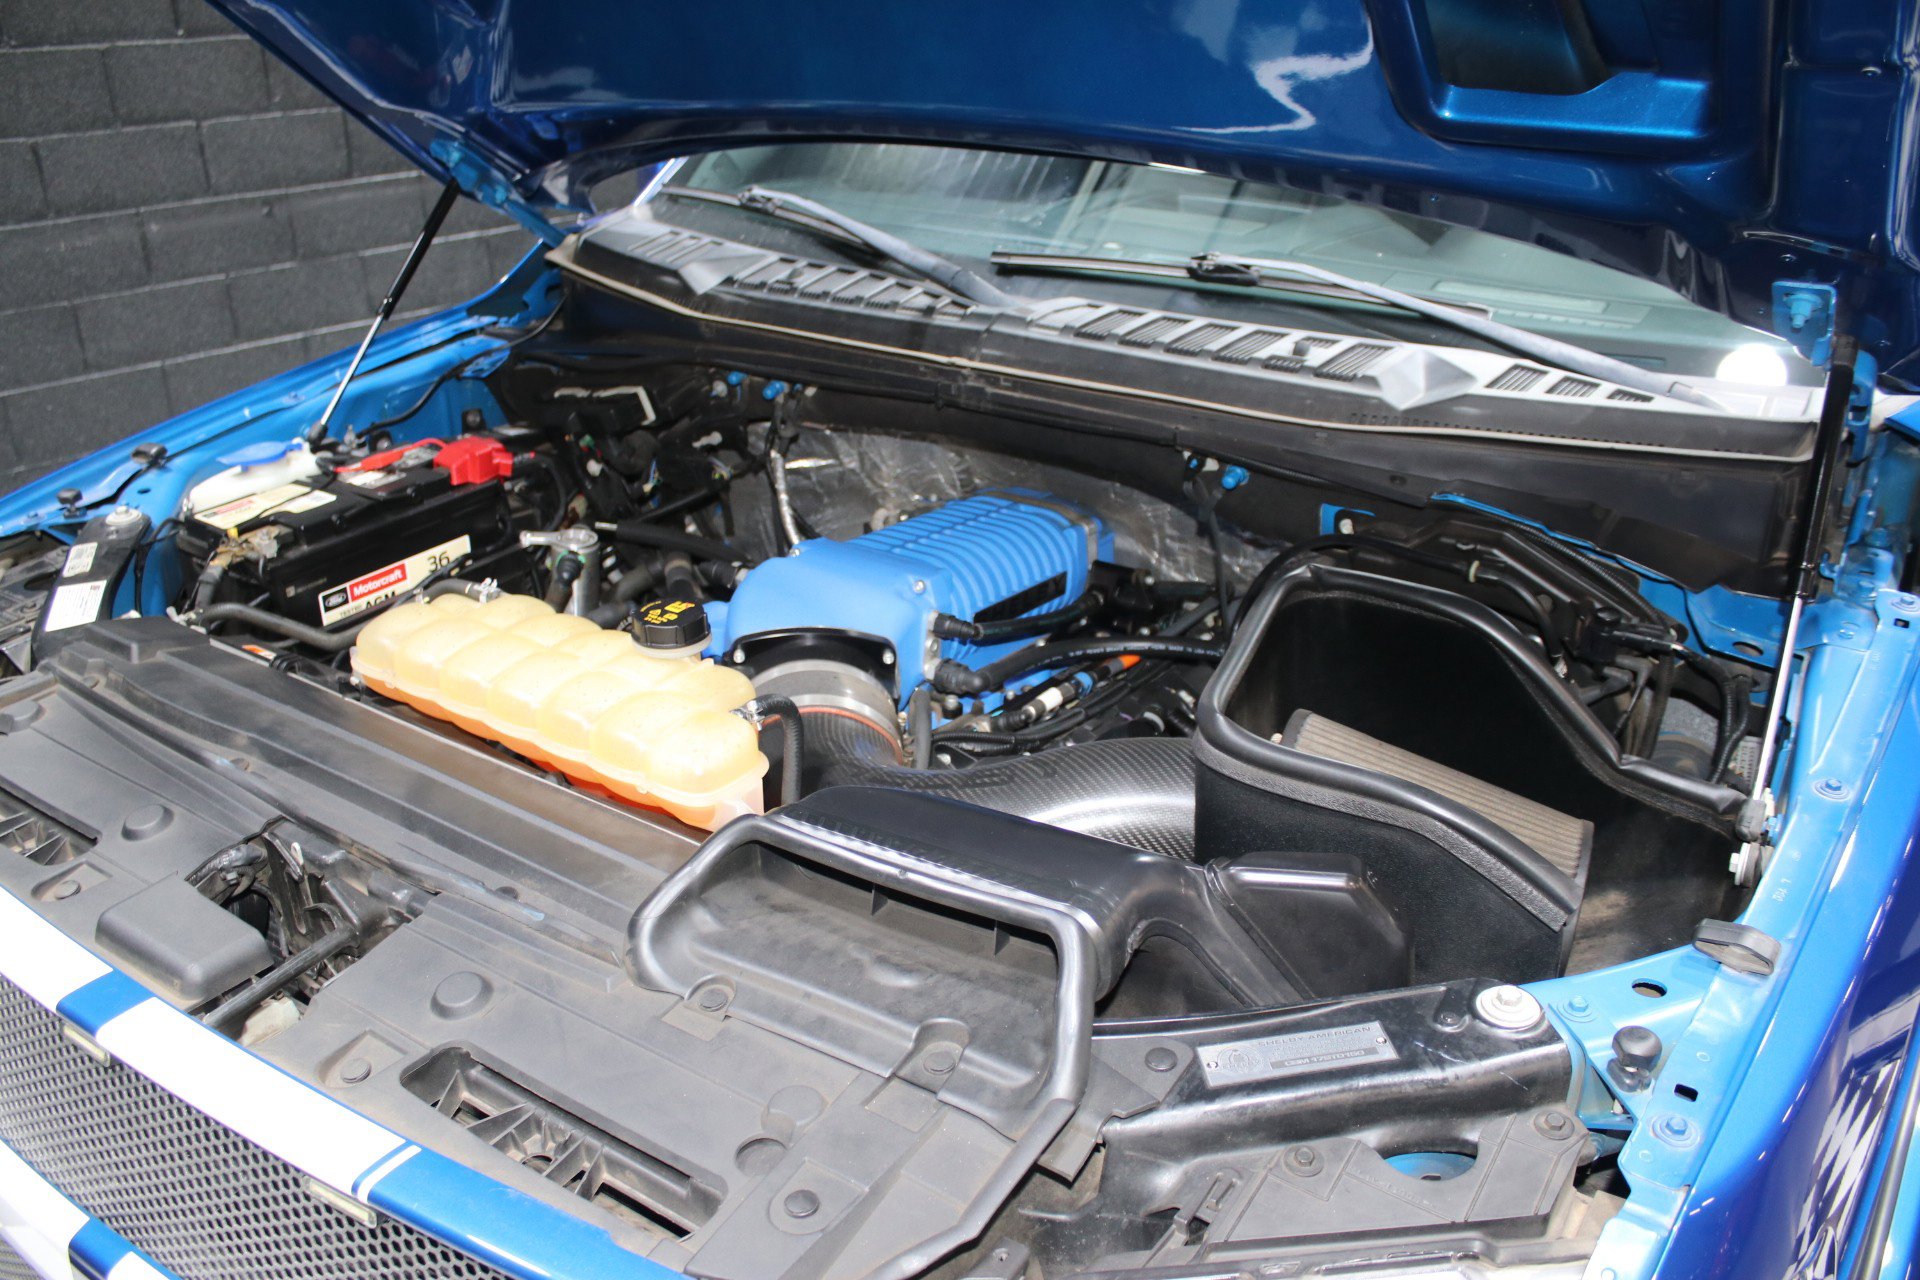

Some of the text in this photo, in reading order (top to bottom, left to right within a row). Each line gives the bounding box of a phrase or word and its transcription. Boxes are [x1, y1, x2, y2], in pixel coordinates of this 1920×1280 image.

[427, 551, 450, 573] 36
[353, 568, 404, 597] Motorcraft
[1258, 1035, 1304, 1047] SHELBY
[1308, 1026, 1372, 1040] AMERICAN
